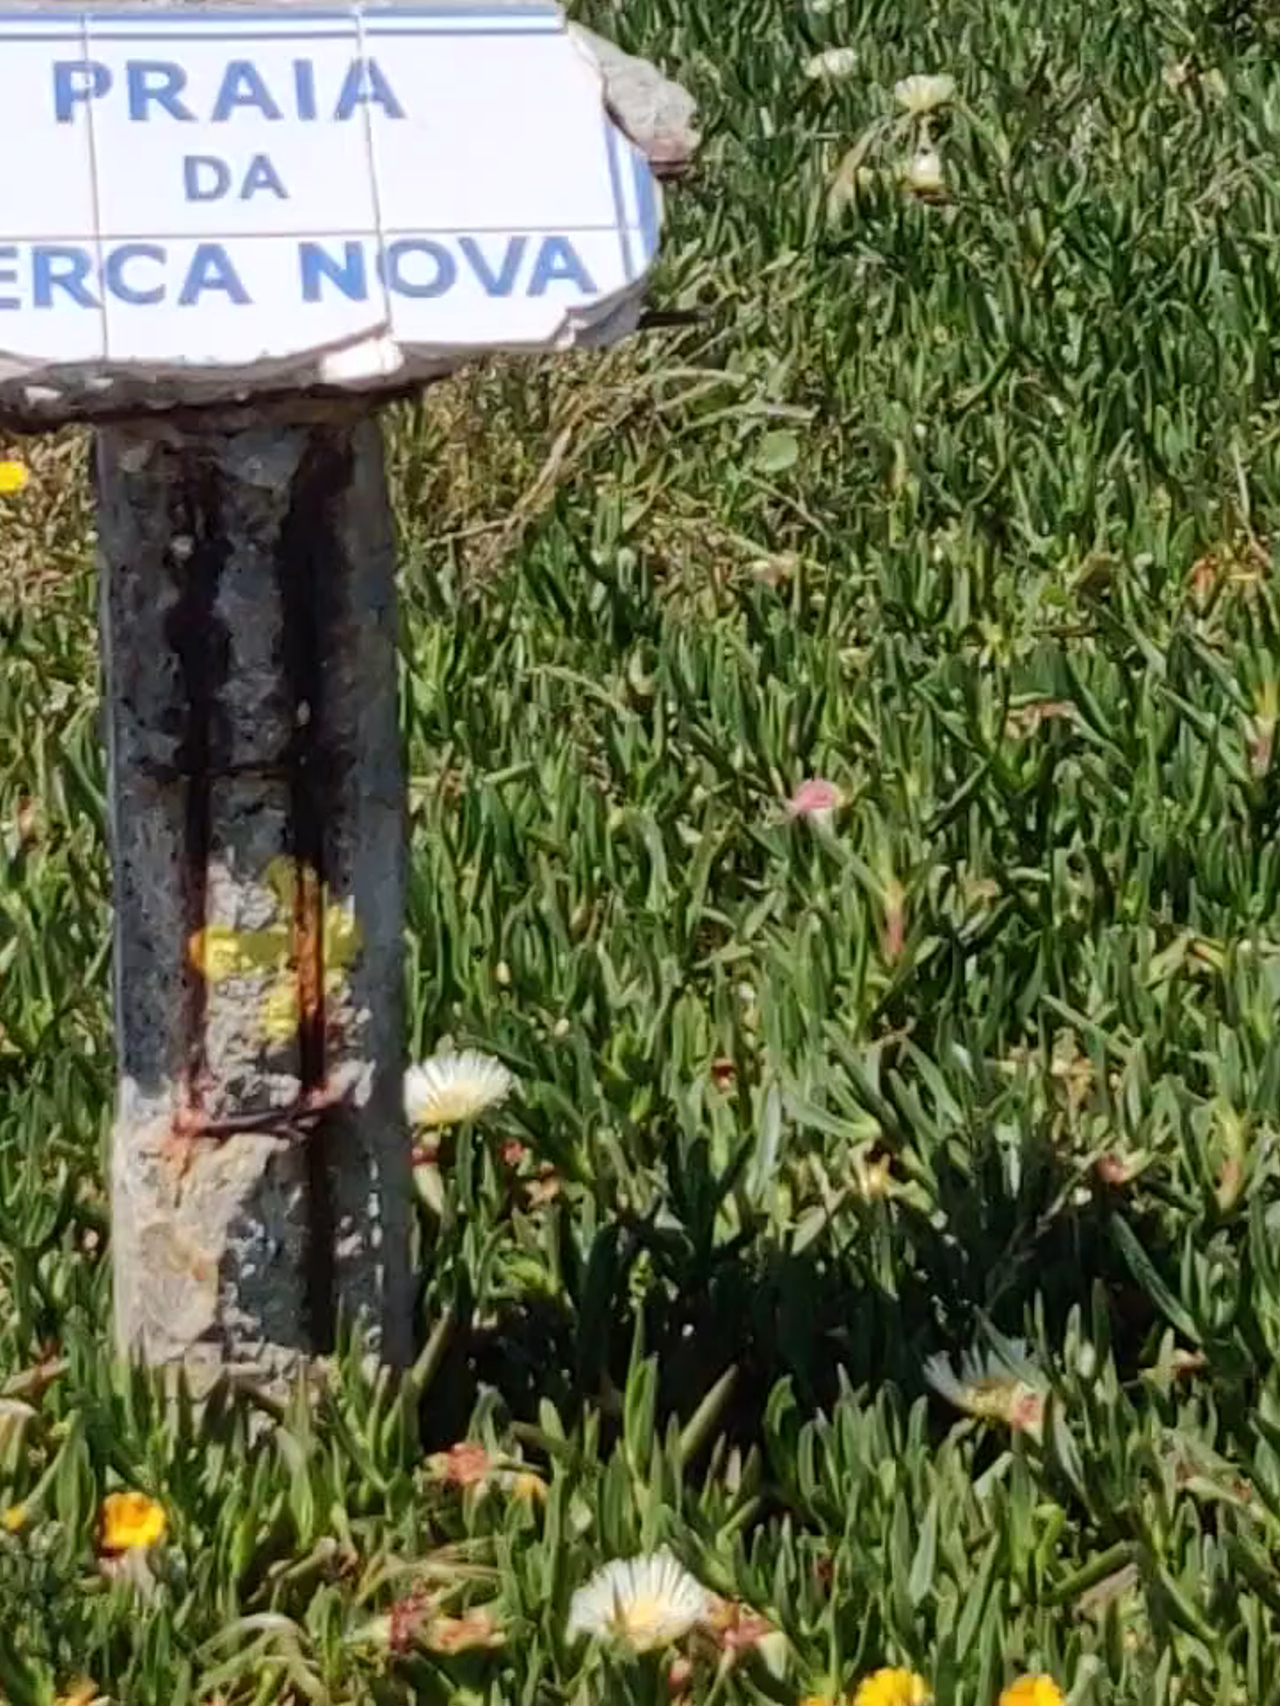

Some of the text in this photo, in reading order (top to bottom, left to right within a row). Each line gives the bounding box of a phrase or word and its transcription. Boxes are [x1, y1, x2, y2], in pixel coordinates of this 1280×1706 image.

[52, 58, 407, 123] PRAIA
[183, 154, 290, 202] DA
[299, 236, 598, 302] NOVA
